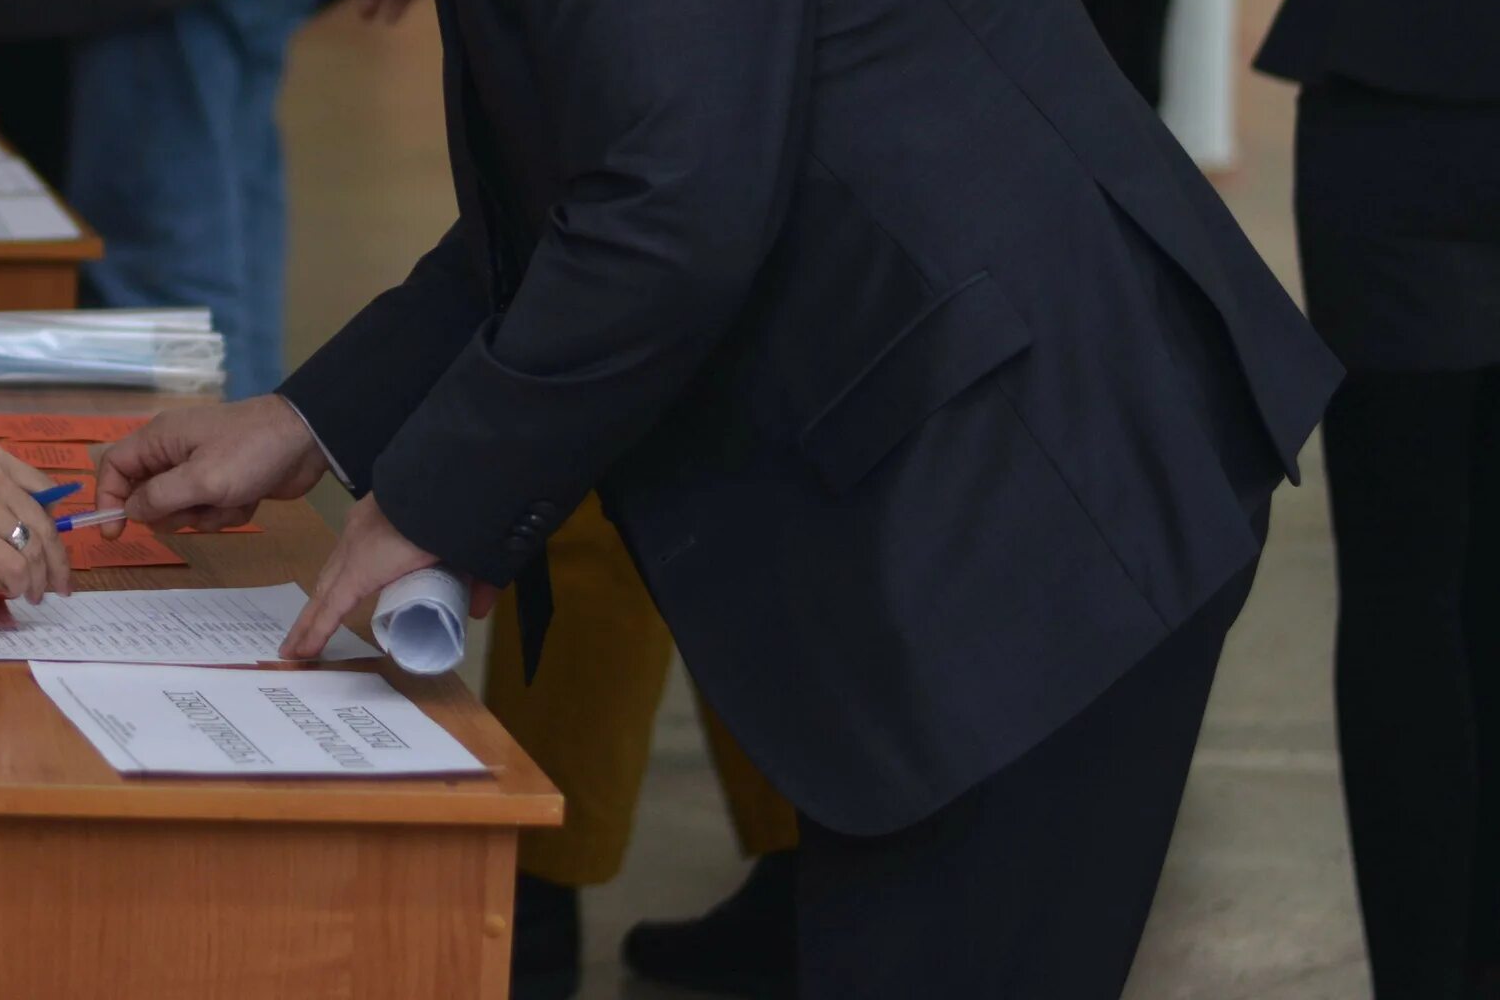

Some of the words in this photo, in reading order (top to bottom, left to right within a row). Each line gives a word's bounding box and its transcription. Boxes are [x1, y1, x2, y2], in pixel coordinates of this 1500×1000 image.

[161, 690, 220, 721] СОВЕТ
[257, 687, 374, 768] ПОДРАЗДЕЛЕНИЯ
[331, 705, 403, 749] РЕКТОРА
